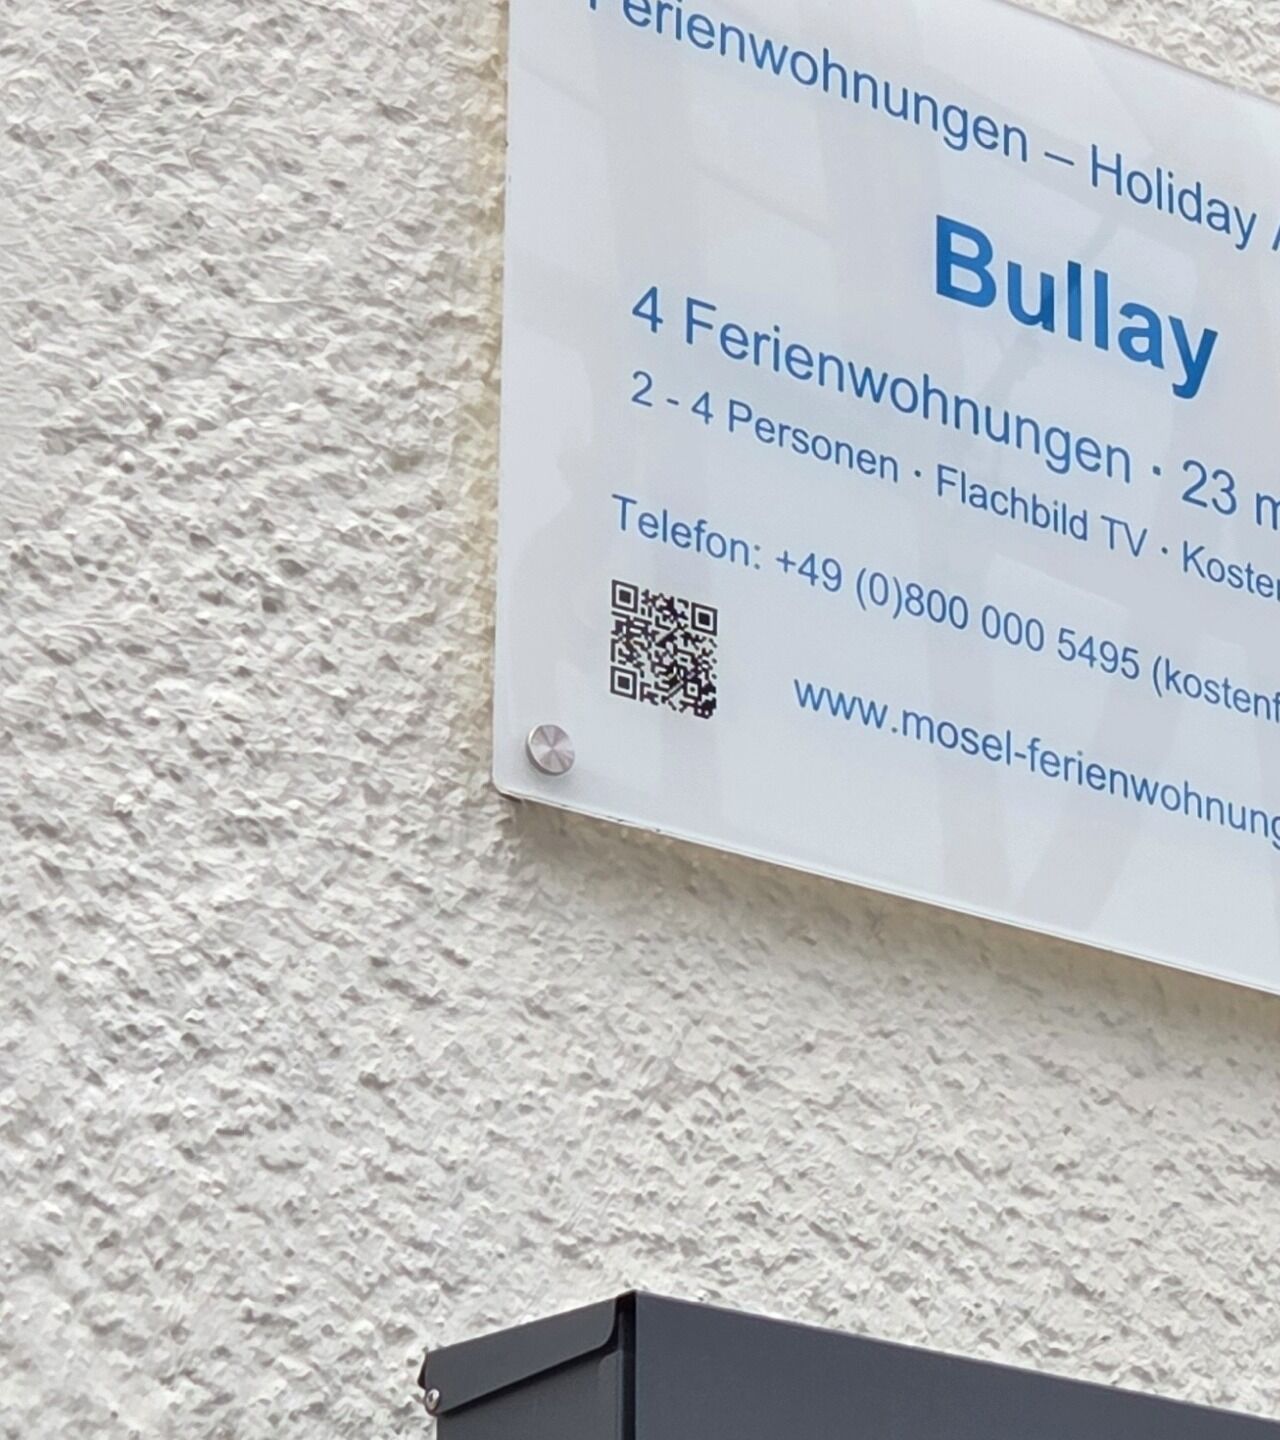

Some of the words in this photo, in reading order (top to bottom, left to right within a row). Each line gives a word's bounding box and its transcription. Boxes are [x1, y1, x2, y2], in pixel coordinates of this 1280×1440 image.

[590, 0, 1027, 162] erienwohnungen
[1092, 144, 1257, 250] Holiday
[936, 215, 1218, 399] Bullay
[632, 286, 663, 333] 4
[686, 297, 1130, 484] Ferienwohnungen
[1182, 460, 1237, 515] 23
[632, 371, 652, 407] 2
[691, 392, 713, 424] 4
[729, 399, 898, 483] Personen
[937, 464, 1088, 541] Flachbild
[1100, 515, 1147, 557] TV
[612, 494, 760, 570] Telefon:
[776, 550, 842, 592] +49
[856, 568, 968, 630] (0)800
[982, 605, 1044, 651] 000
[1058, 628, 1139, 680] 5495
